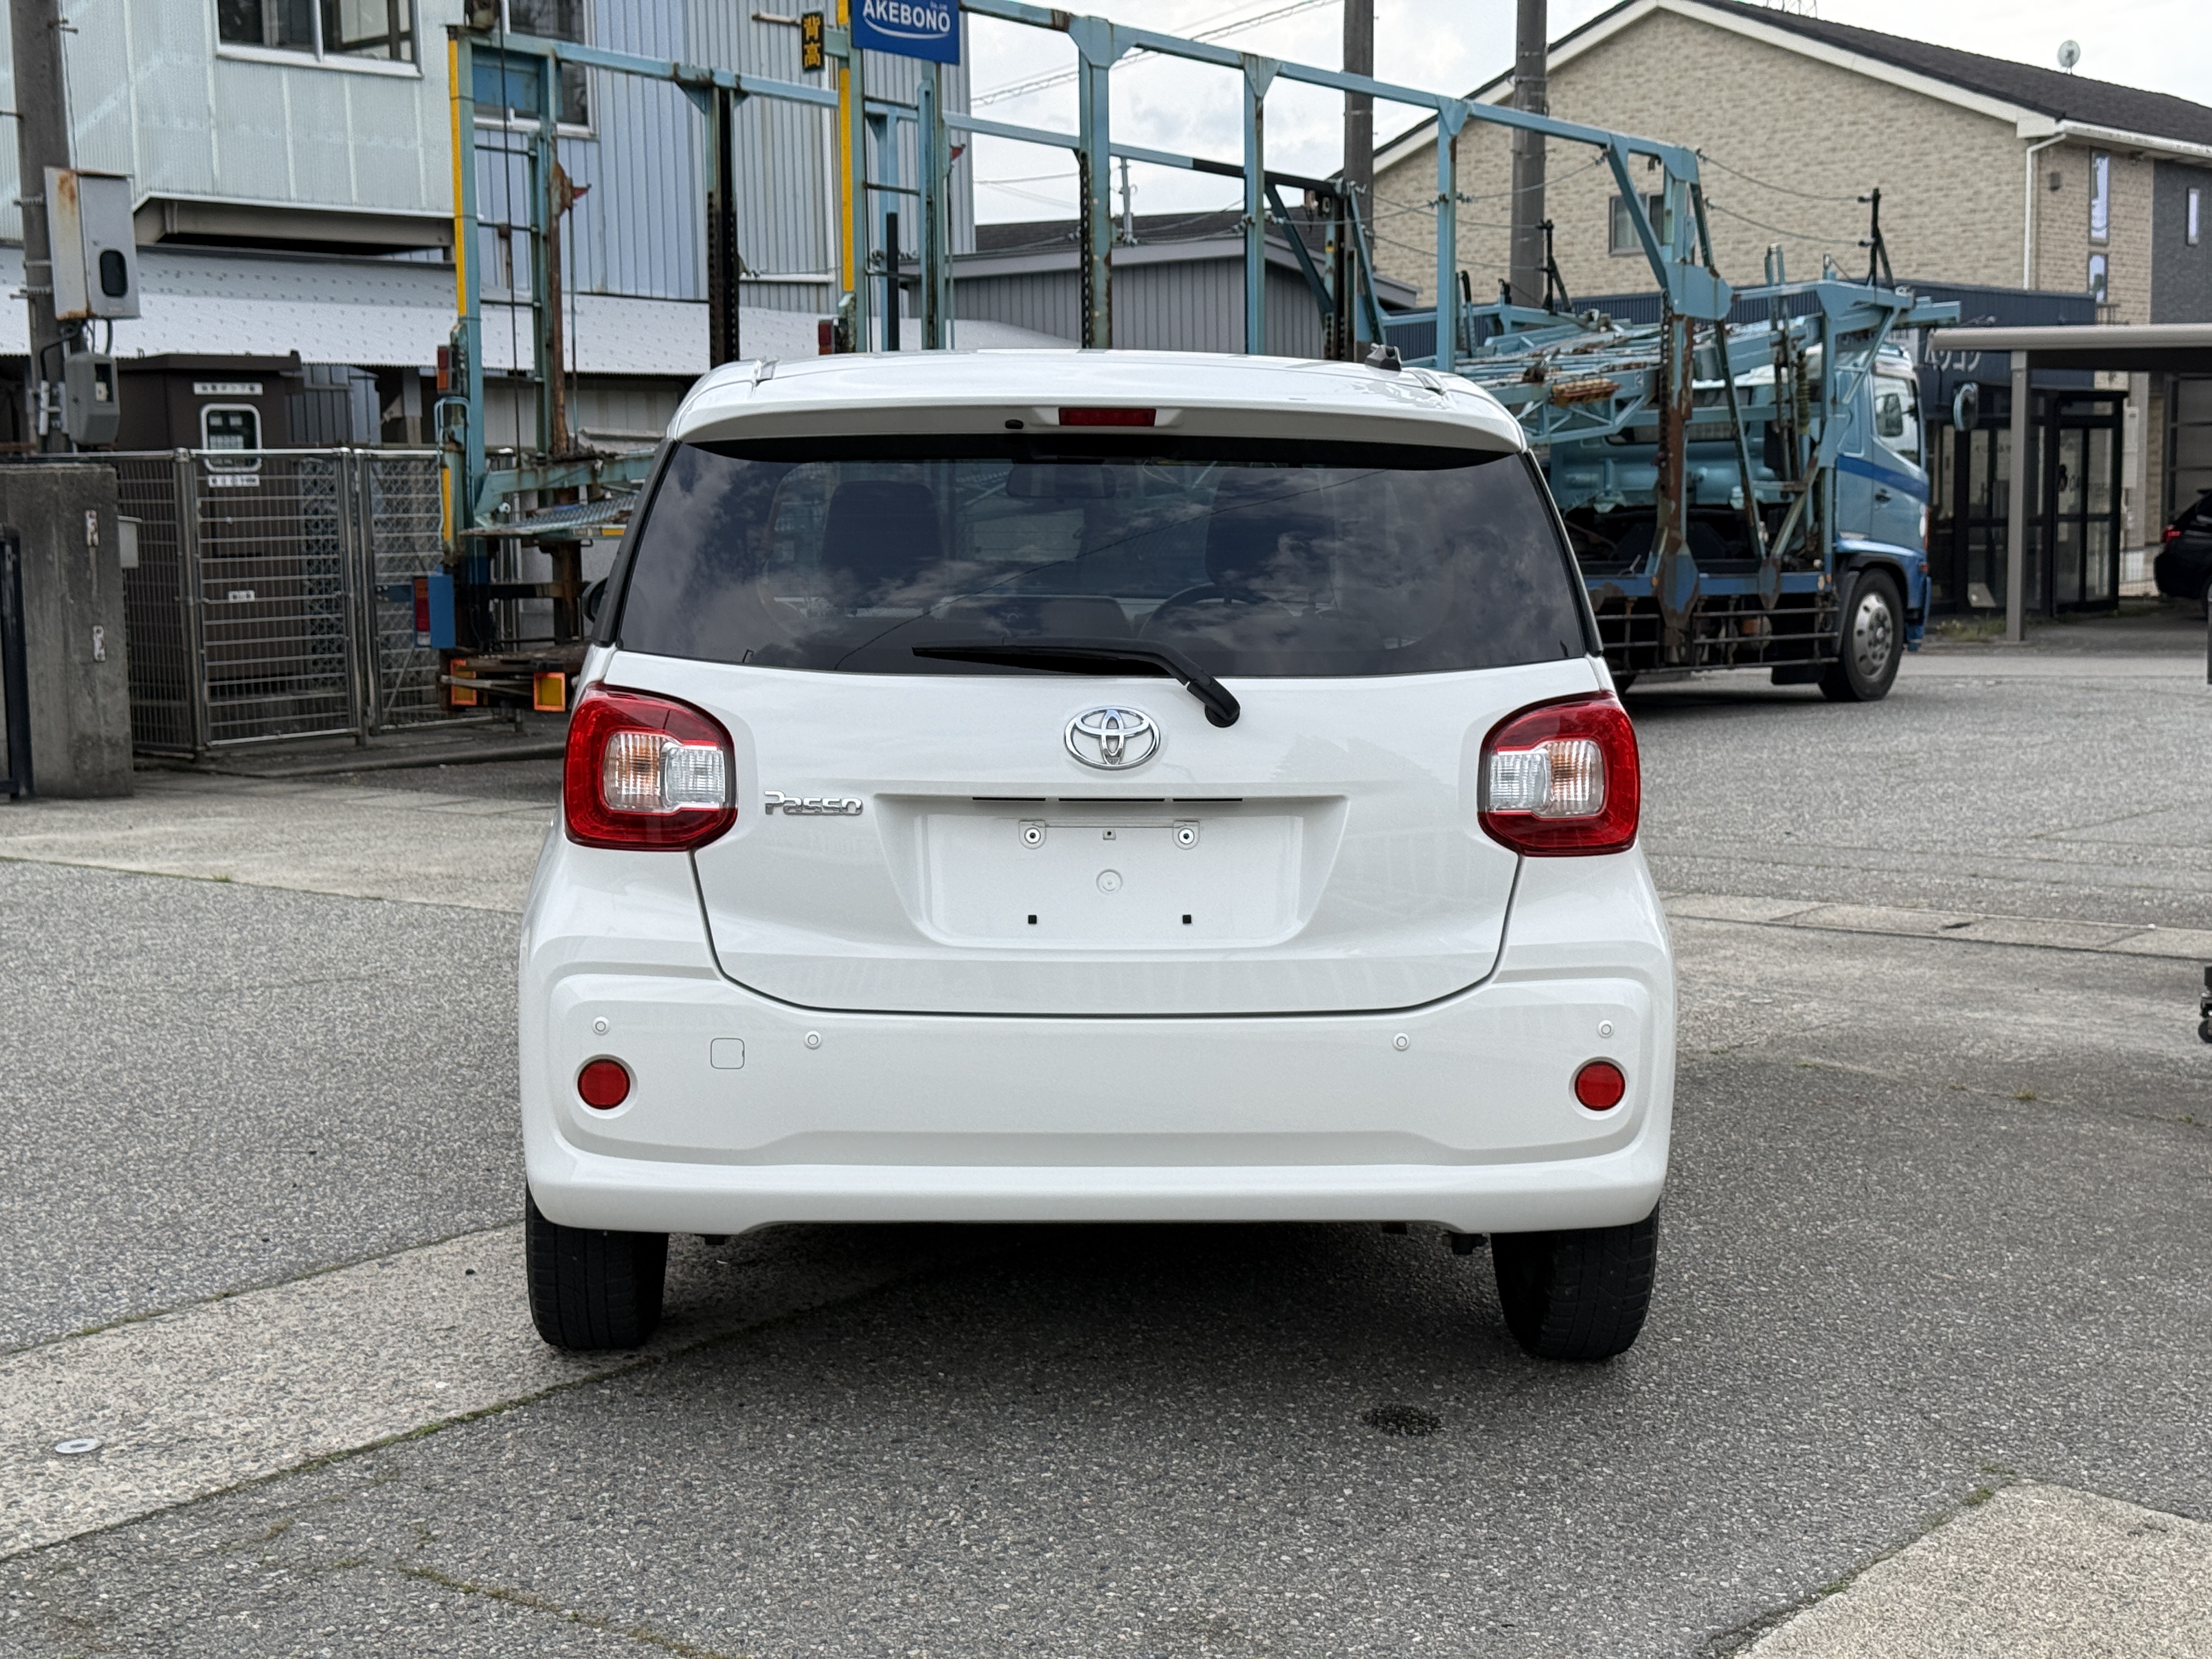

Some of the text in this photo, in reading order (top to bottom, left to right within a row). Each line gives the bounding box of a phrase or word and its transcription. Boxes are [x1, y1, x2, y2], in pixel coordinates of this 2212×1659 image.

[863, 0, 951, 32] AKEBONO
[804, 15, 821, 67] 背高
[764, 791, 864, 816] Passo
